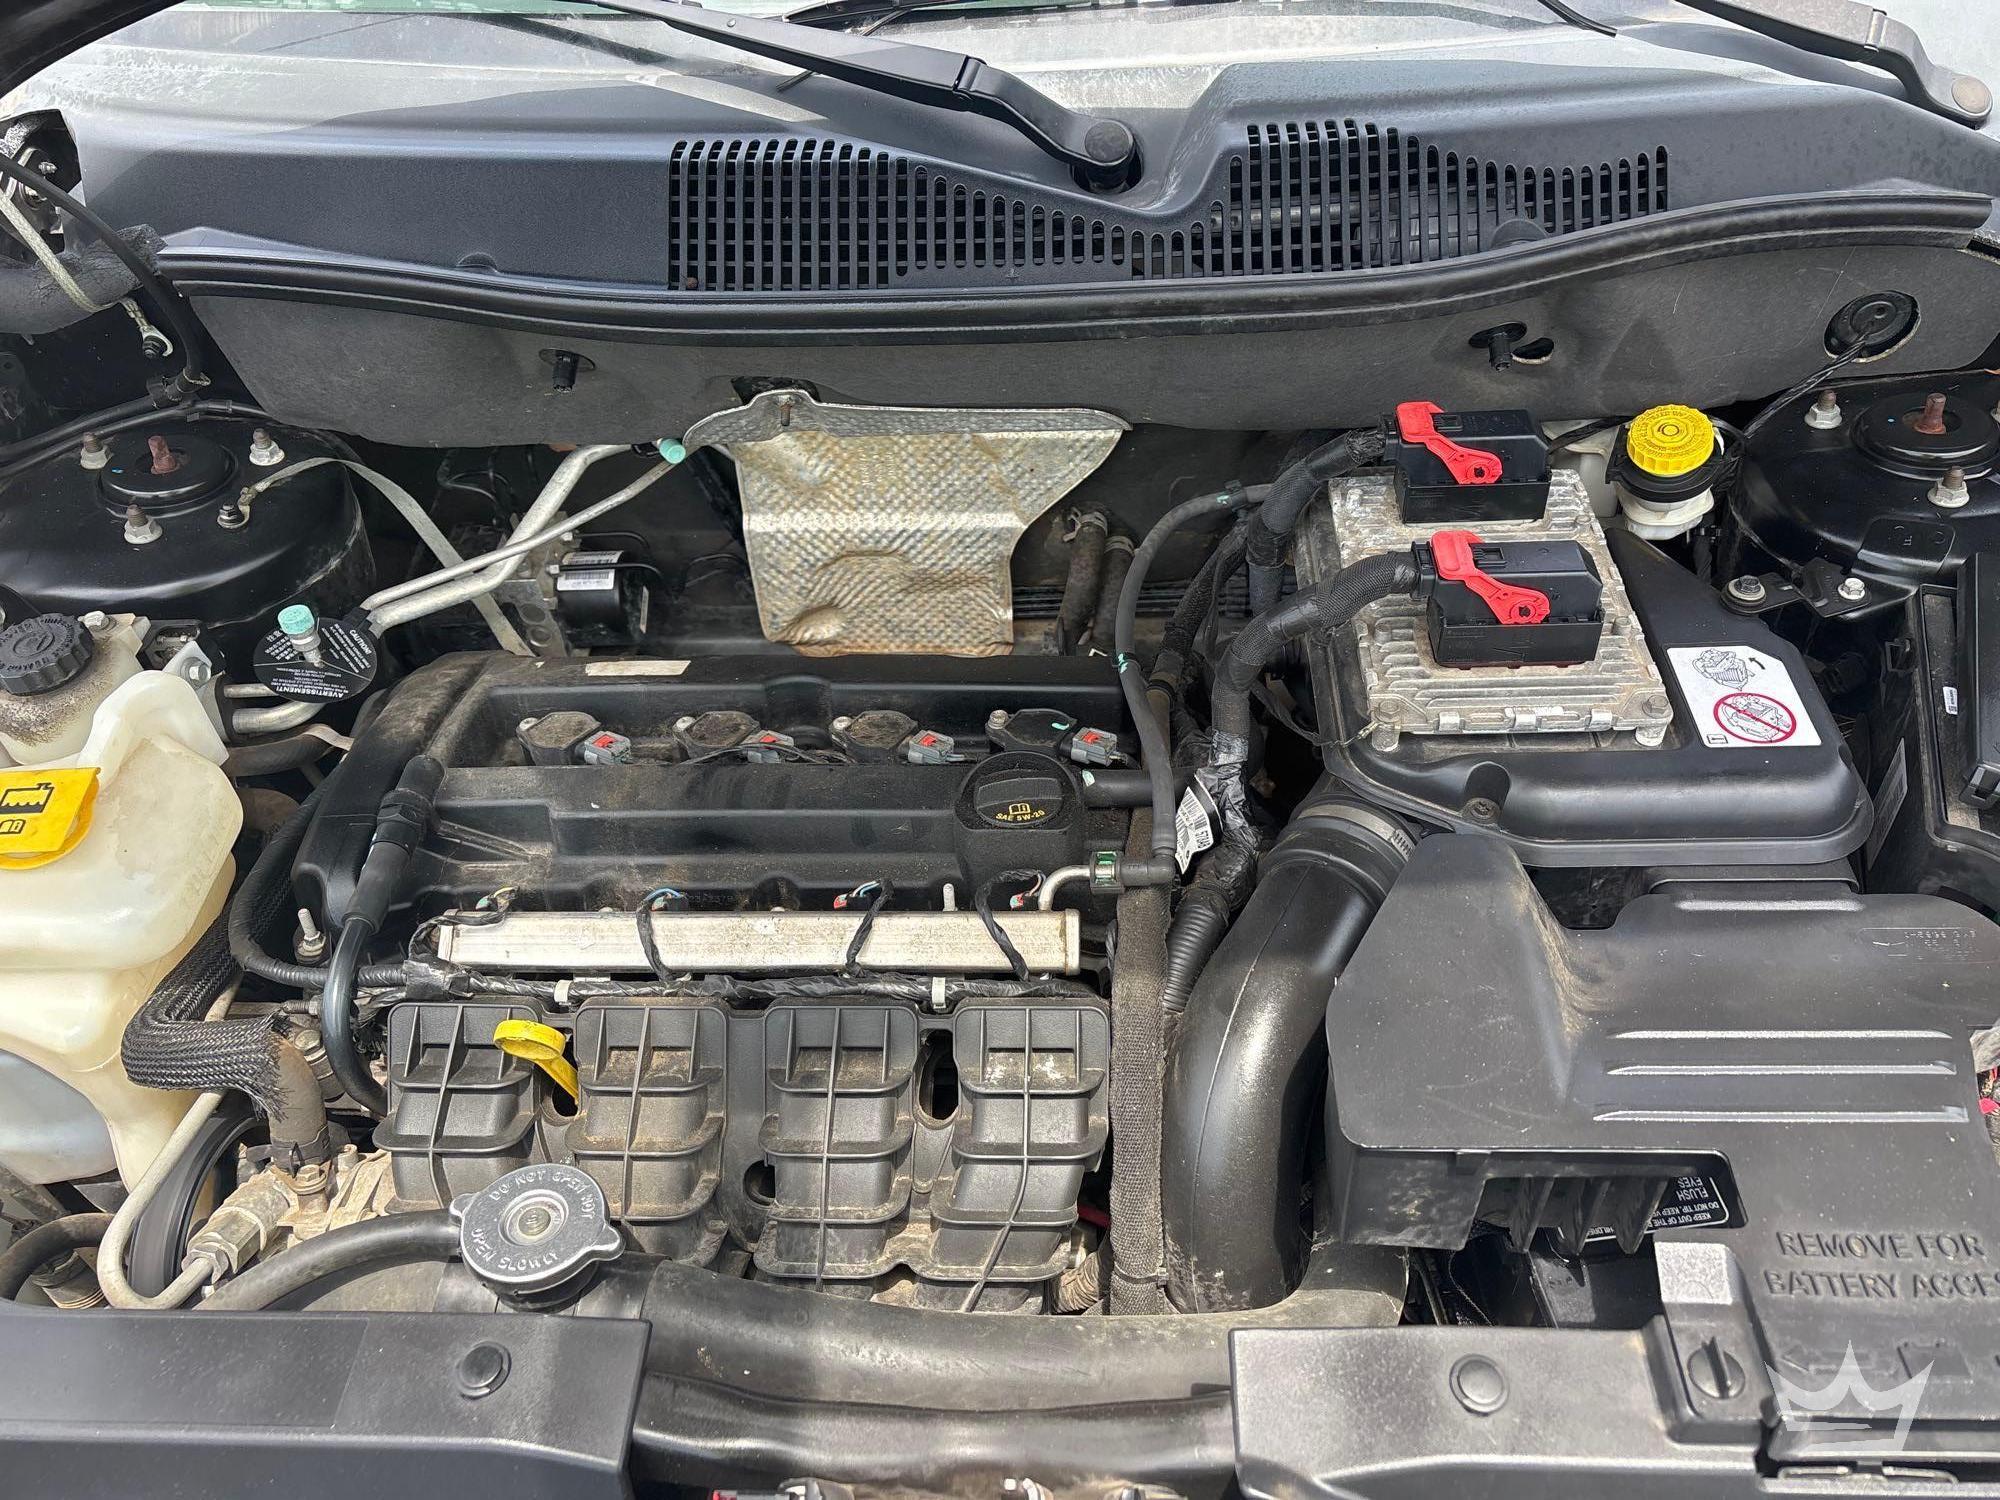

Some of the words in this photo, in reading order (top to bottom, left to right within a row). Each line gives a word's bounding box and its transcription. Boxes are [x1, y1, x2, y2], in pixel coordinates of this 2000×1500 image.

[349, 629, 373, 655] CAUTION!
[995, 812, 1014, 821] SAE
[1016, 809, 1046, 821] 5W-20
[489, 1183, 511, 1201] DO
[514, 1170, 547, 1186] NOT
[1675, 1187, 1709, 1201] FLUSH
[1693, 1203, 1708, 1212] NOT
[1708, 1201, 1720, 1209] DO
[1661, 1207, 1680, 1216] KEEP
[1693, 1212, 1711, 1221] KEEP
[1654, 1218, 1668, 1227] THE
[1668, 1216, 1678, 1225] OF
[1677, 1214, 1693, 1223] OUT
[1775, 1231, 1913, 1260] REMOVE
[1916, 1233, 1986, 1259] FOR
[497, 1252, 560, 1271] SLOWLY
[1763, 1269, 1898, 1299] BATTERY
